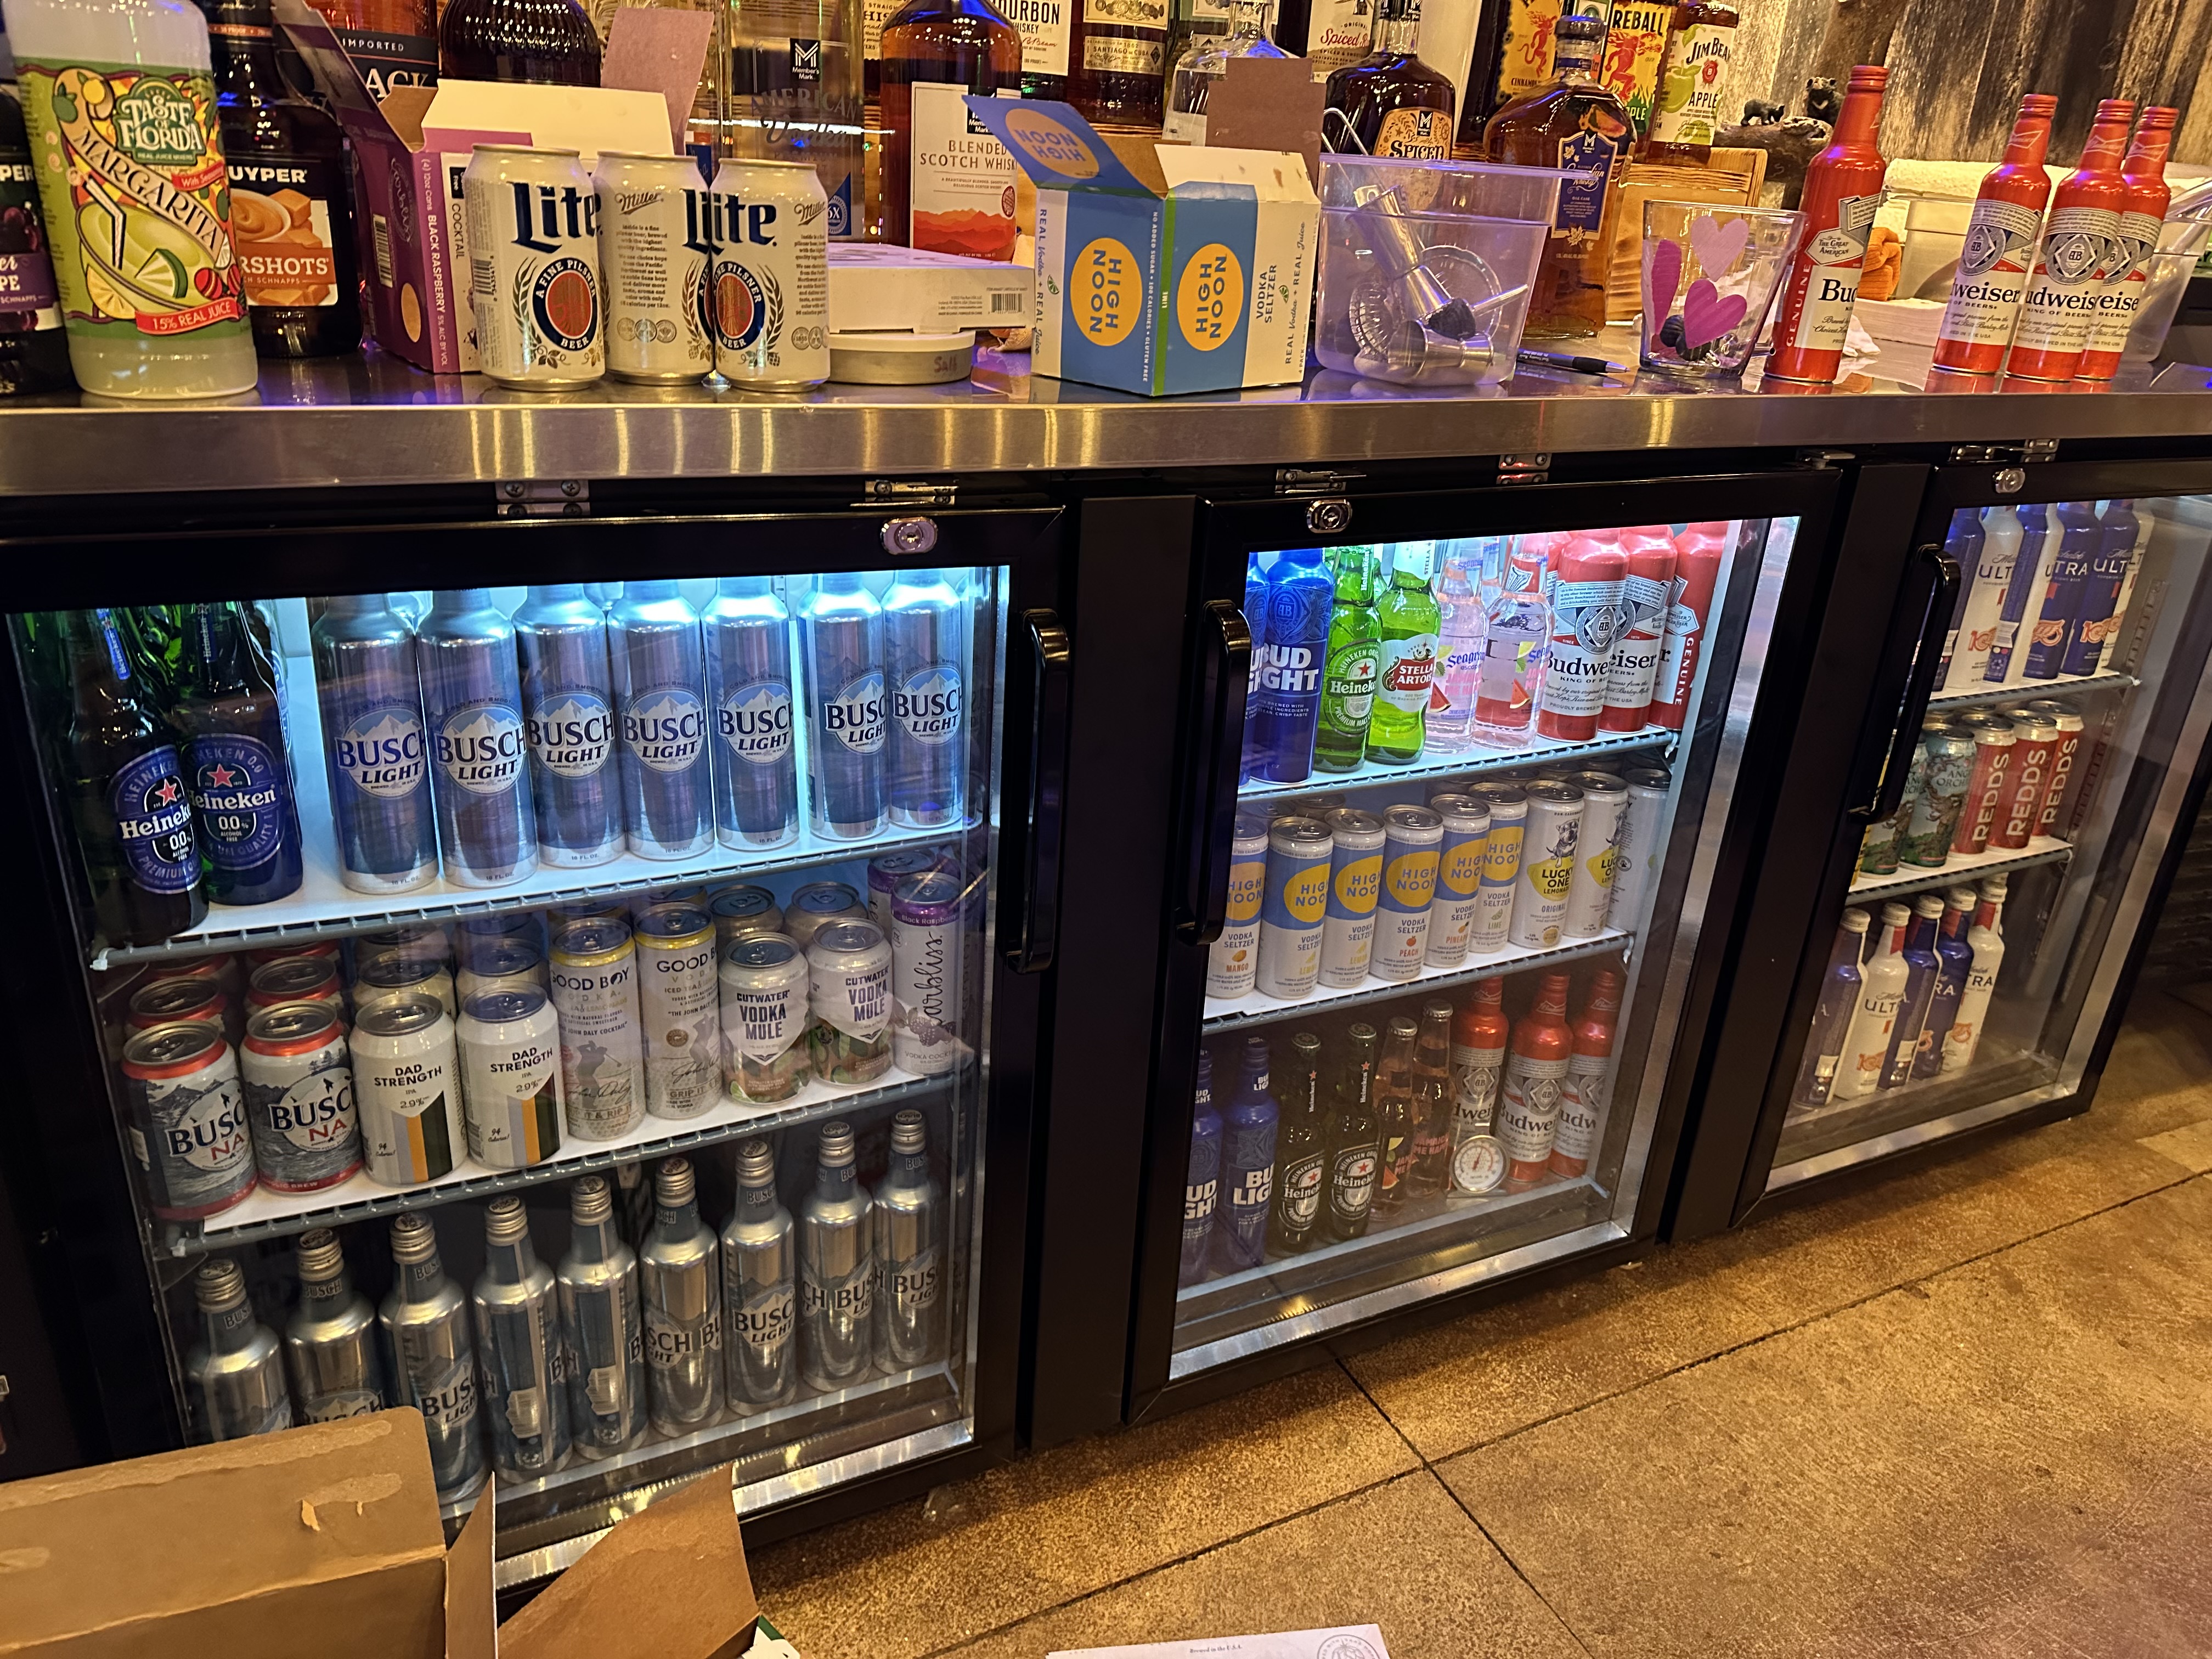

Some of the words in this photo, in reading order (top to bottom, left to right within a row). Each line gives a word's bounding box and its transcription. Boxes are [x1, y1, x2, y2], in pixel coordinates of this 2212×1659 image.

[1612, 10, 1664, 36] REBALL
[342, 38, 404, 52] IMPORTED
[1321, 28, 1361, 46] Spiced
[1093, 46, 1127, 54] SANTIAGO
[1686, 41, 1709, 65] JIM
[121, 95, 191, 128] TASTE
[752, 88, 857, 122] AMERICAN
[1689, 92, 1718, 109] APPLE
[119, 120, 202, 151] FLORIDA
[949, 140, 1007, 155] BLENDED
[1390, 140, 1444, 160] SPICED
[921, 153, 978, 168] SCOTCH
[73, 127, 224, 250] MARGARITA
[614, 191, 662, 215] Miller
[507, 182, 602, 253] Lite
[1039, 208, 1048, 241] REAL
[1153, 212, 1158, 225] NO
[427, 215, 440, 251] BLACK
[452, 203, 465, 259] COCKTAIL
[1297, 222, 1305, 250] Juice
[1037, 244, 1046, 278] Vodka
[1819, 248, 1849, 257] AMERICAN
[240, 256, 328, 275] RSHOTS
[1293, 253, 1302, 285] REAL
[431, 252, 445, 313] RASPBERRY
[539, 262, 562, 288] FINE
[567, 259, 597, 298] PILSNER
[727, 263, 762, 303] PILSNER
[1949, 277, 2021, 303] weiser
[1090, 250, 1106, 334] NOON
[1104, 258, 1122, 329] HIGH
[1195, 263, 1212, 333] HIGH
[1210, 255, 1227, 338] NOON
[1256, 271, 1268, 319] VODKA
[1265, 264, 1277, 323] SELTZER
[2025, 286, 2095, 310] udweis
[153, 316, 177, 329] 15%
[179, 309, 204, 327] REAL
[204, 302, 231, 321] JUICE
[1035, 291, 1043, 329] REAL
[1289, 300, 1297, 329] Vodka
[1786, 264, 1811, 347] GENUINE
[561, 336, 590, 349] BEER
[723, 338, 747, 349] BEER
[1034, 328, 1043, 355] Juice
[1285, 333, 1294, 364] REAL
[1361, 550, 1370, 592] Heineken
[1978, 565, 2012, 579] ULT
[2093, 558, 2126, 573] ULT
[1262, 643, 1312, 669] BUD
[1339, 649, 1367, 673] HEINEKEN
[1397, 673, 1432, 684] ARTOIS
[1399, 663, 1434, 675] STELLA
[1673, 636, 1694, 706] GENUINE
[1334, 706, 1356, 727] PREMIUM
[1549, 702, 1575, 710] PROUDLY
[527, 710, 615, 746] BUSCH
[624, 707, 707, 743] BUSCH
[911, 714, 958, 733] LIGHT
[438, 727, 526, 763] BUSCH
[641, 741, 698, 758] LIGHT
[737, 732, 789, 751] LIGHT
[546, 746, 604, 763] LIGHT
[361, 760, 421, 784] LIGHT
[458, 760, 518, 780] LIGHT
[2040, 737, 2078, 825] REDD'S
[1936, 778, 1966, 787] ORCH
[2007, 748, 2047, 837] REDD'S
[188, 784, 276, 810] Heineken
[1972, 753, 2009, 842] REDD'S
[1483, 853, 1520, 865] NOON
[1488, 841, 1521, 854] HIGH
[1228, 879, 1261, 890] HIGH
[1396, 878, 1436, 891] NOON
[1402, 867, 1436, 879] HIGH
[1547, 877, 1569, 888] ONE
[1483, 898, 1511, 907] SELTZER
[1487, 891, 1510, 900] VODKA
[901, 915, 920, 924] Black
[921, 914, 957, 926] Raspberry
[1455, 904, 1475, 915] VODKA
[1351, 923, 1373, 933] VODKA
[1397, 924, 1427, 934] SELTZER
[1401, 918, 1425, 927] VODKA
[1488, 921, 1502, 930] LIME
[1224, 938, 1254, 949] SELTZER
[1227, 932, 1253, 941] VODKA
[657, 953, 708, 973] GOOD
[1398, 948, 1419, 958] PEACH
[845, 966, 889, 986] CUTWATER
[1226, 963, 1249, 972] MANGO
[737, 989, 790, 1003] CUTWATER
[848, 979, 888, 1006] VODKA
[684, 1007, 698, 1015] JOHN
[739, 1003, 786, 1023] VODKA
[854, 997, 885, 1023] MULE
[745, 1022, 782, 1040] MULE
[490, 1047, 553, 1073] STRENGTH
[512, 1047, 537, 1061] DAD
[905, 1051, 928, 1060] VODKA
[374, 1065, 442, 1087] STRENGTH
[394, 1064, 423, 1076] DAD
[670, 1090, 695, 1098] GRIP
[270, 1086, 351, 1131] BUSC
[167, 1099, 246, 1156] BUSC
[308, 1118, 347, 1142] NA
[210, 1133, 245, 1161] NA
[1245, 1163, 1273, 1189] BU
[1233, 1182, 1273, 1205] LIG
[892, 1266, 938, 1294] BUS
[733, 1296, 796, 1332] BUSC
